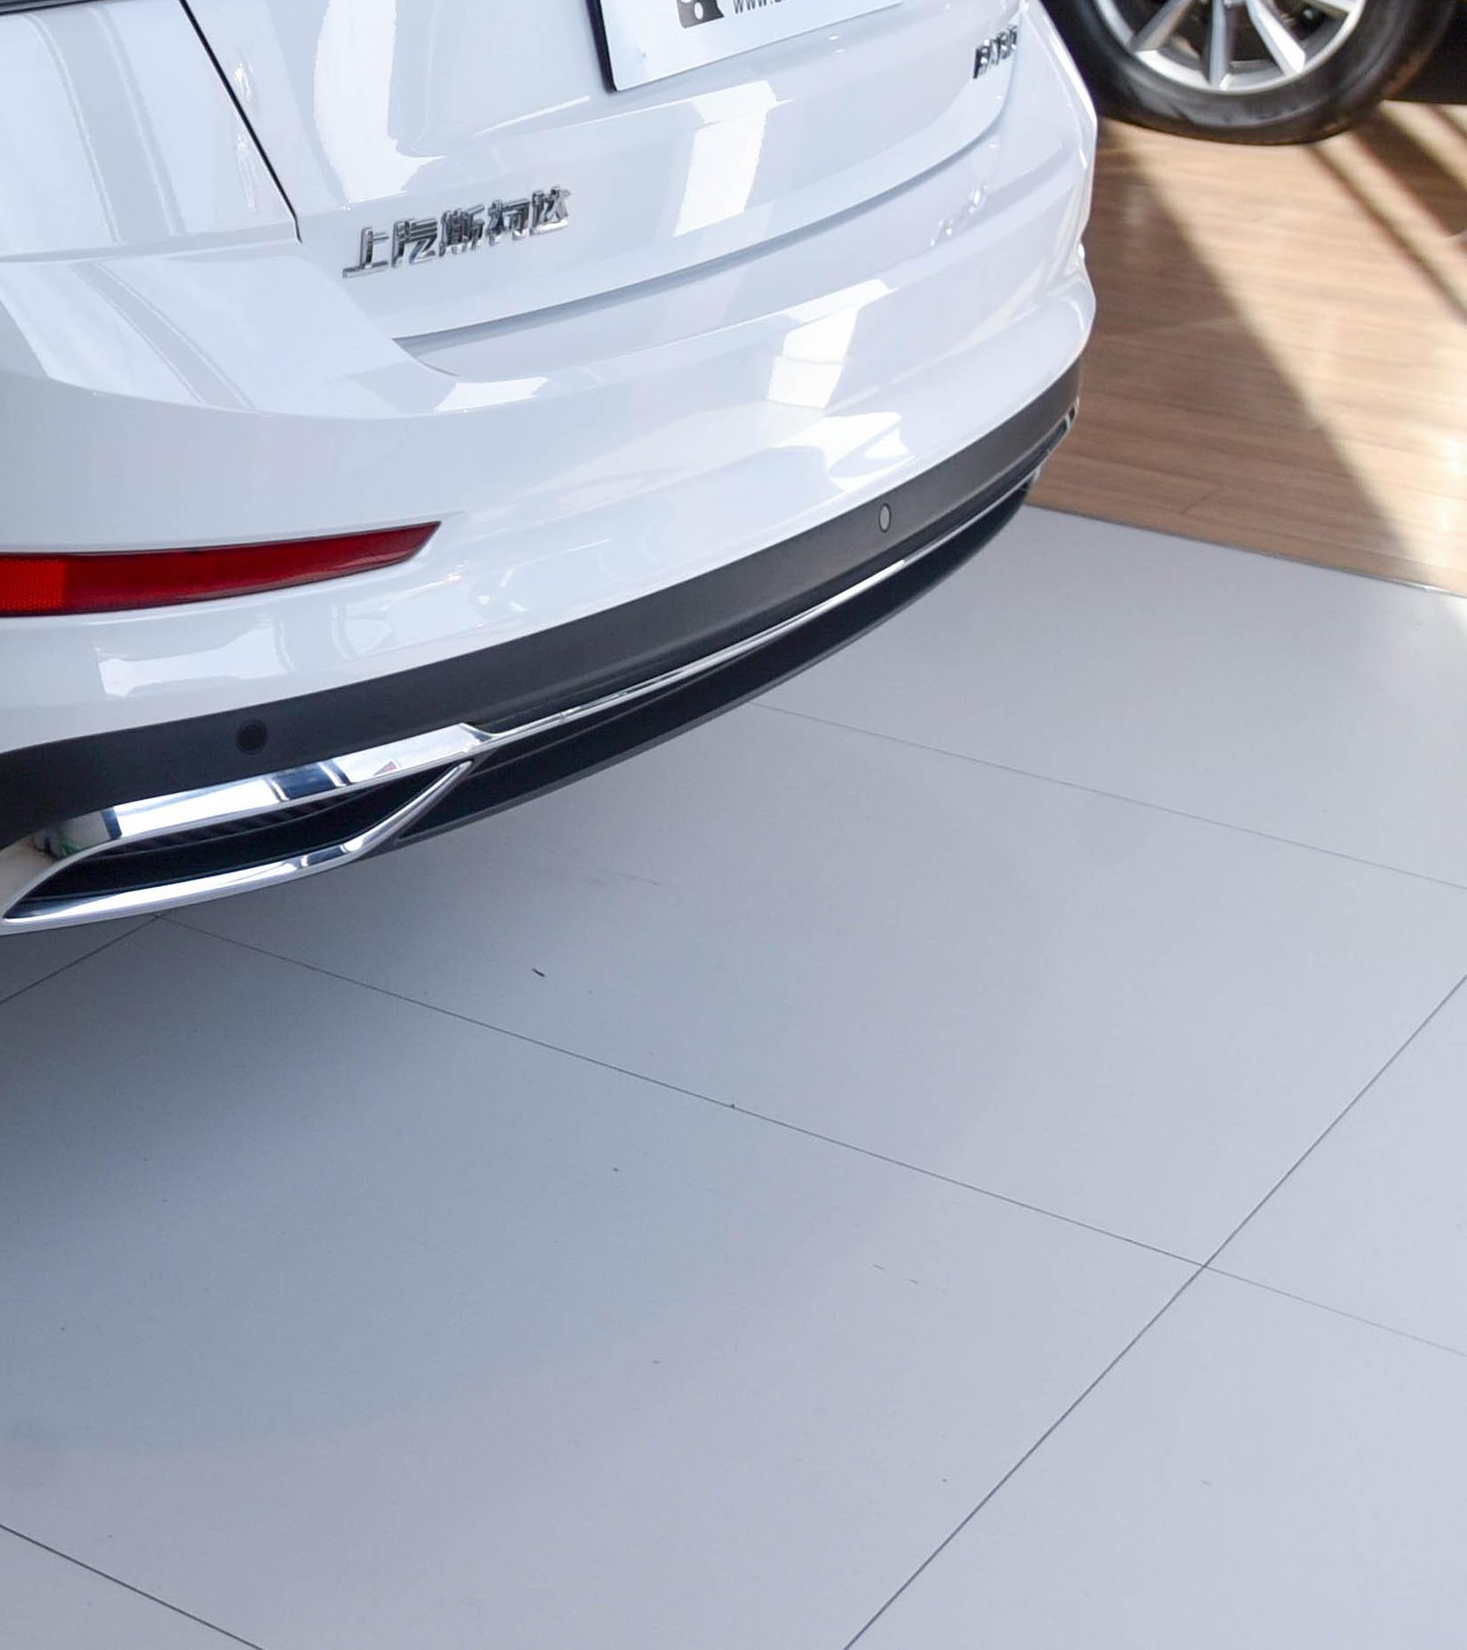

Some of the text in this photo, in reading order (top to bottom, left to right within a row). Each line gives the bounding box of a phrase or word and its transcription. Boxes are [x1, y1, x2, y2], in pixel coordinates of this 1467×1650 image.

[342, 184, 571, 279] 上汽斯柯达
